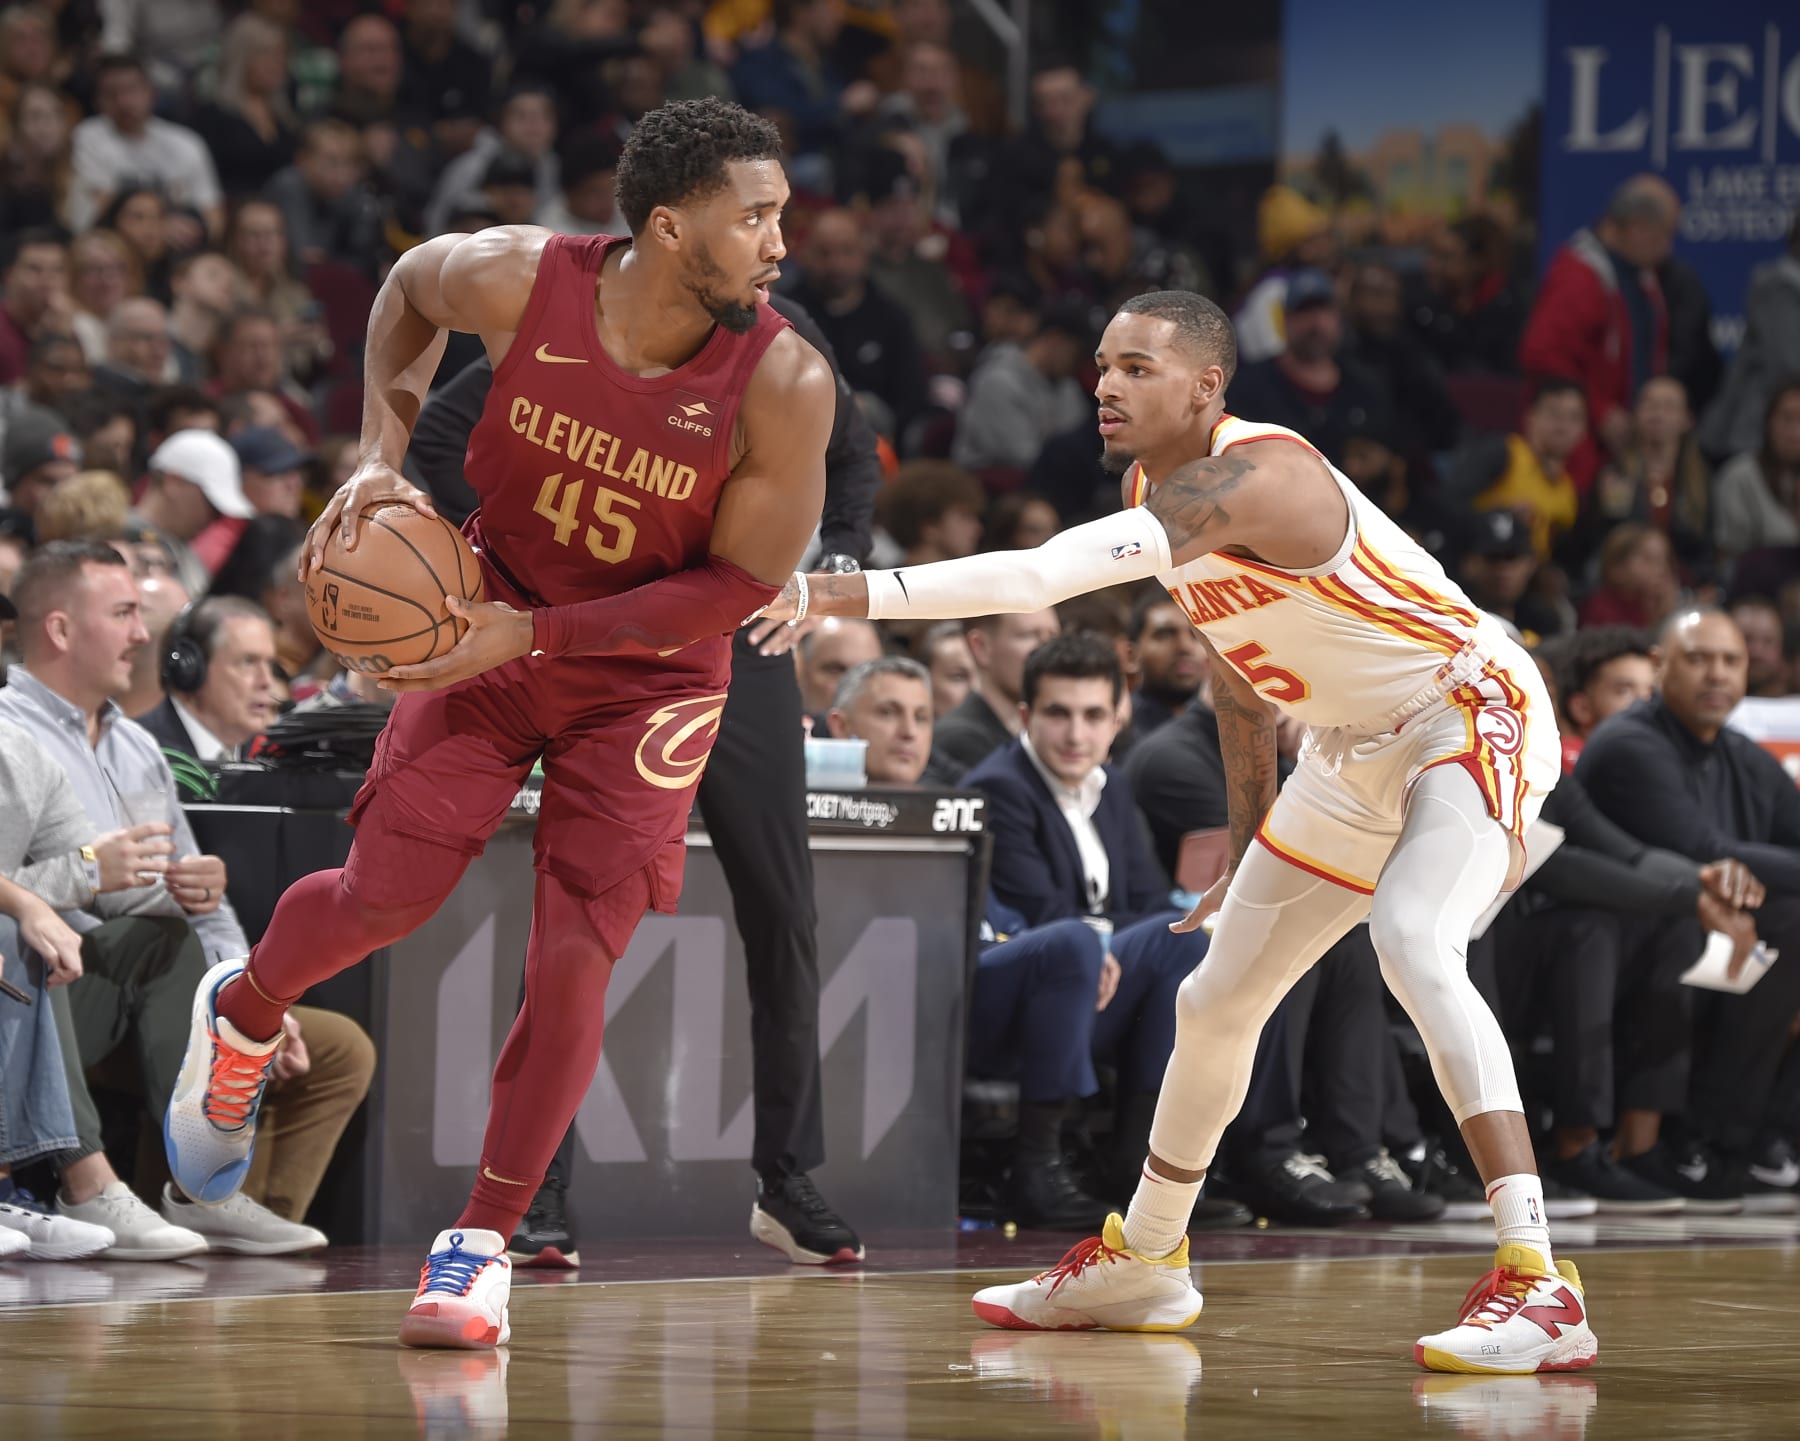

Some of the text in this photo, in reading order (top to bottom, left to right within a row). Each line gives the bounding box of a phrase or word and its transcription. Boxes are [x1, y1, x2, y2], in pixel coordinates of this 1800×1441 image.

[509, 396, 699, 501] CLEVELAND
[667, 415, 713, 437] CLIFFS
[532, 472, 641, 565] 45
[1168, 572, 1290, 625] LANTA
[1219, 639, 1311, 705] 5
[932, 798, 985, 832] anc
